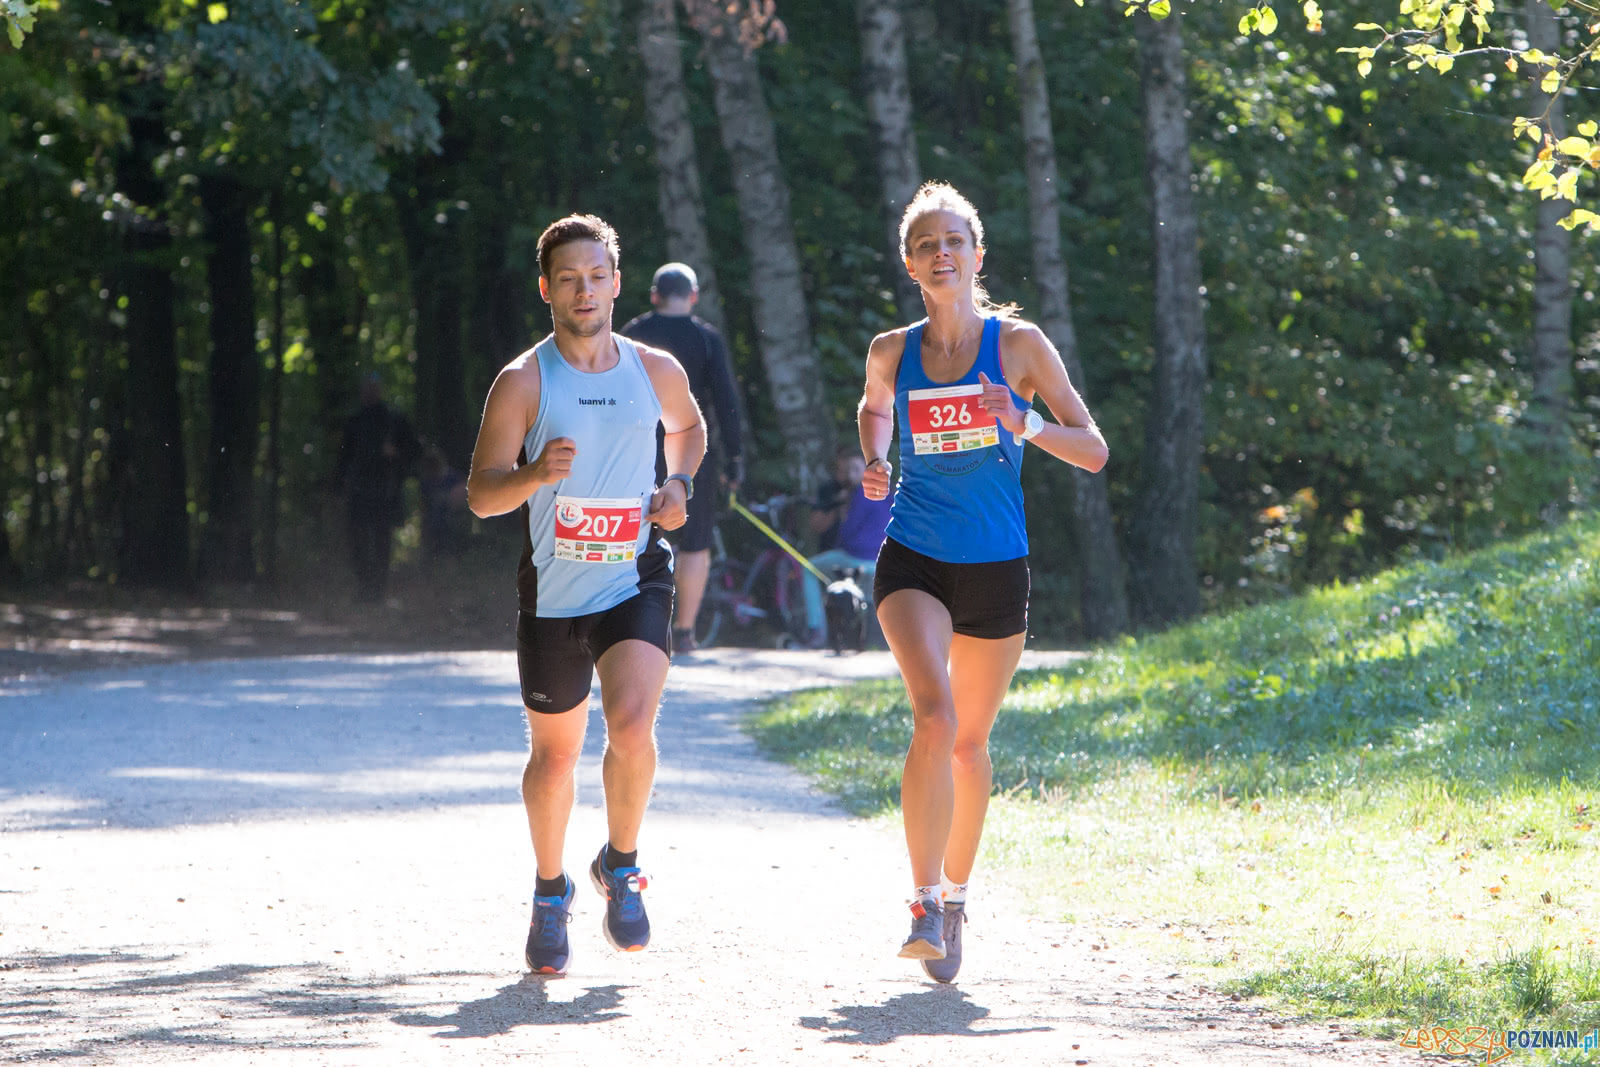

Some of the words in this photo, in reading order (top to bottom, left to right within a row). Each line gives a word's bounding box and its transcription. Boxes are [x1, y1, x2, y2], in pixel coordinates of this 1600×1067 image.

[578, 397, 606, 406] luanvi
[929, 403, 972, 428] 326
[577, 515, 624, 538] 207
